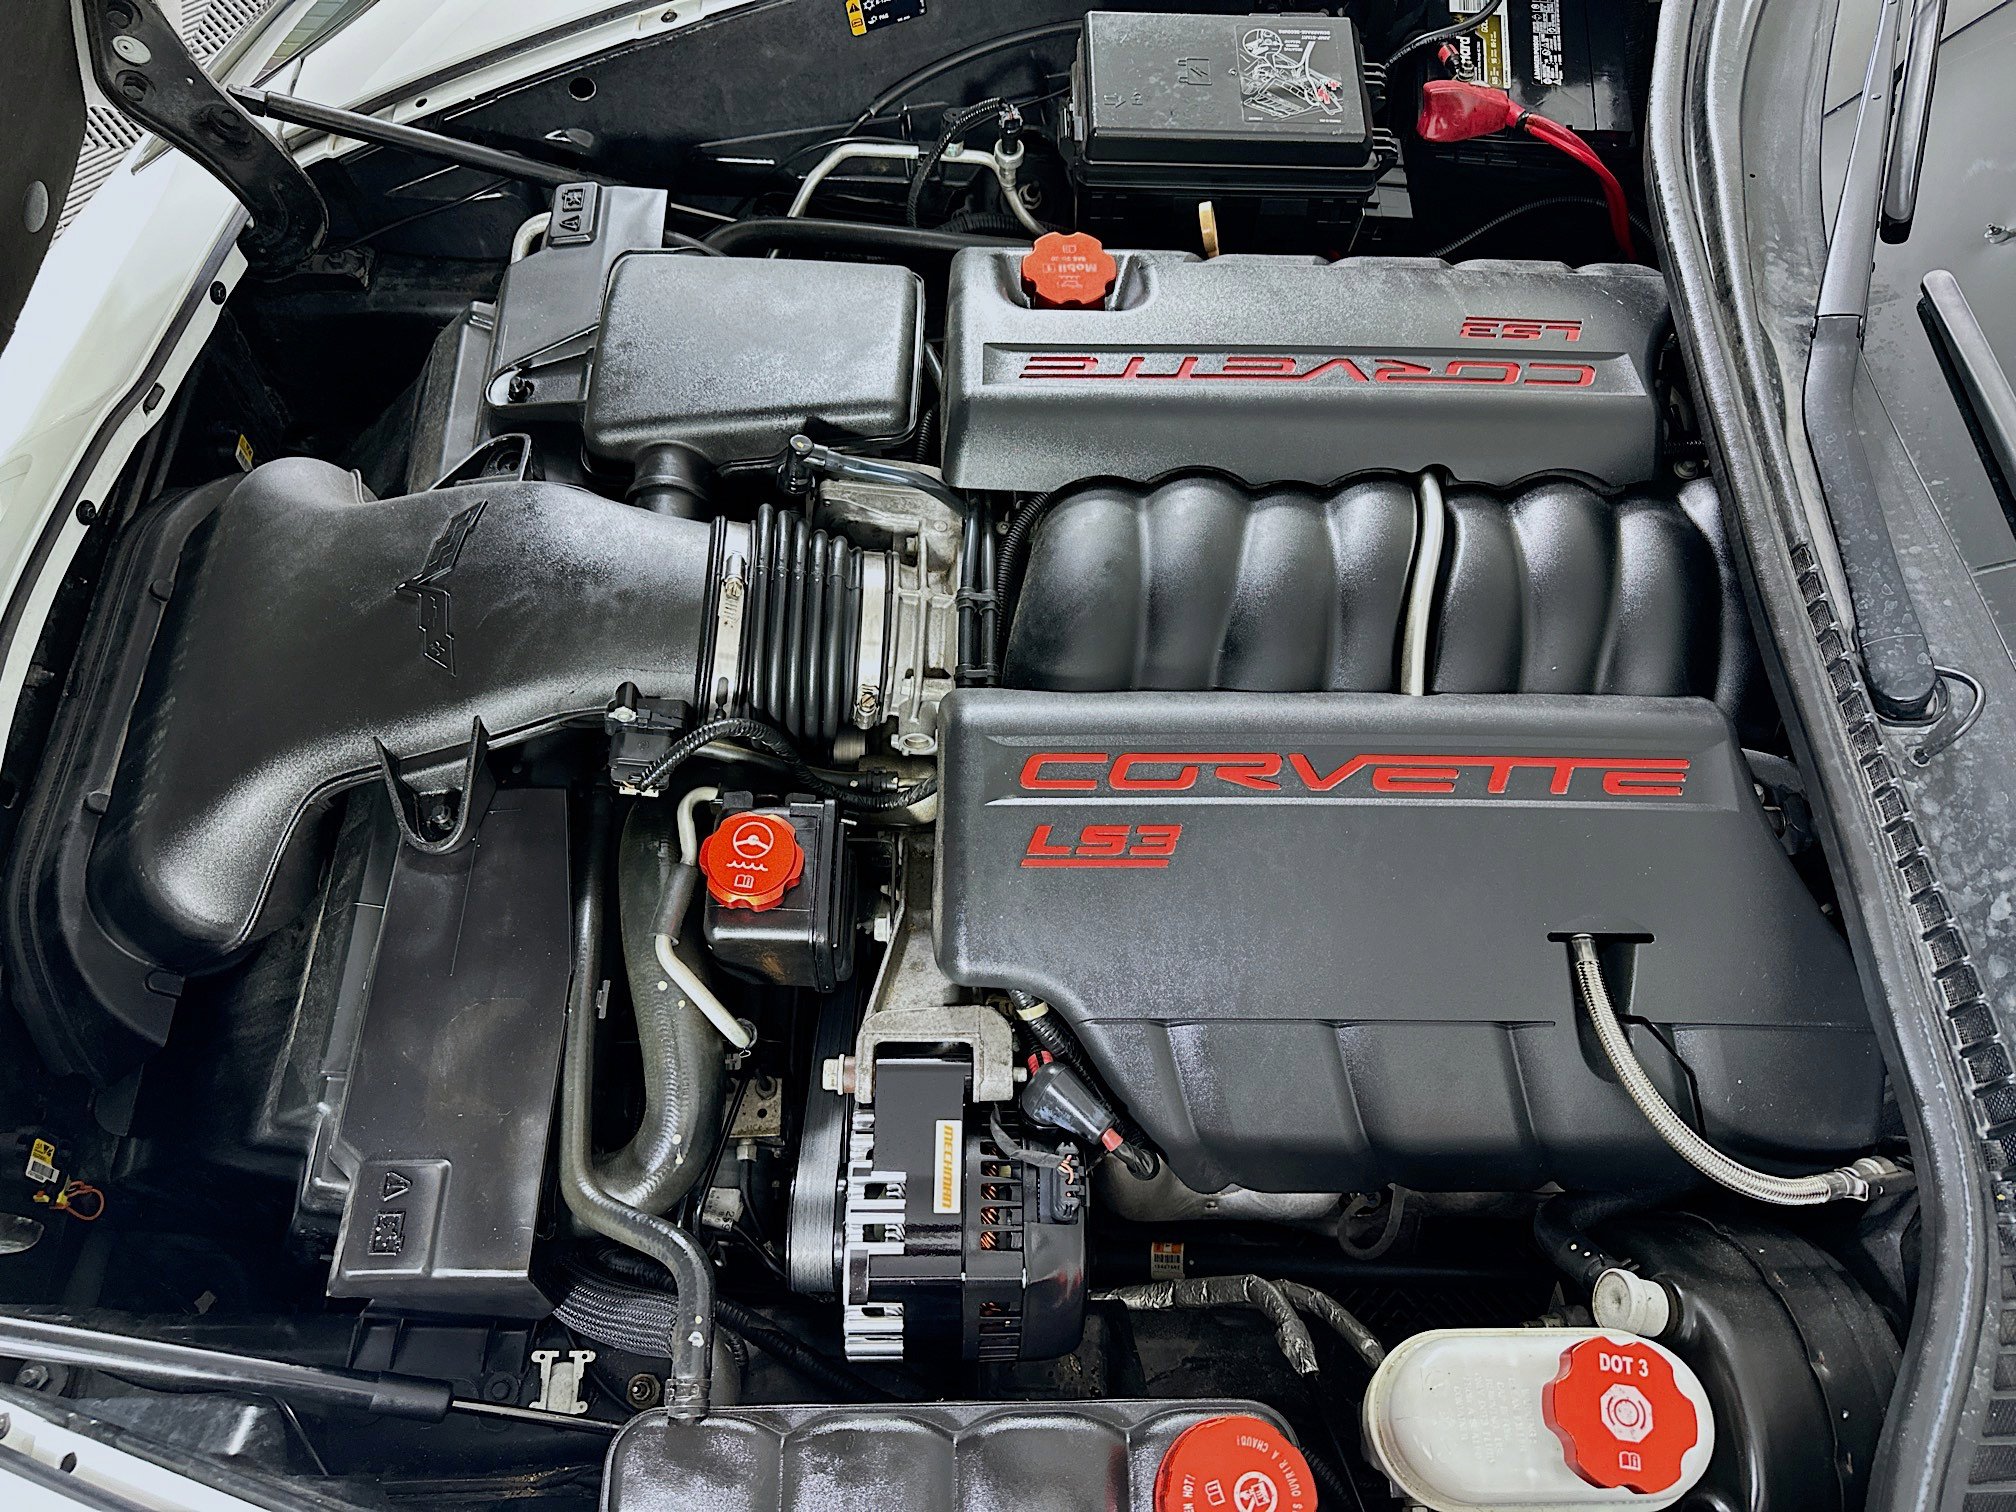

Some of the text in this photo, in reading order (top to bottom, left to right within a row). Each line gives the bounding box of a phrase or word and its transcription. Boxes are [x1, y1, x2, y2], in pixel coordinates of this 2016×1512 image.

[1058, 263, 1098, 273] Mobil
[1460, 319, 1583, 342] LS3
[1018, 356, 1597, 388] CORVETTE
[1018, 751, 1692, 796] CORVETTE
[1023, 823, 1183, 859] LS3
[1598, 1352, 1650, 1378] DOT 3
[1236, 1434, 1270, 1454] CHAUD!
[1181, 1474, 1197, 1499] HOT!
[1278, 1458, 1303, 1498] OUVRIR
